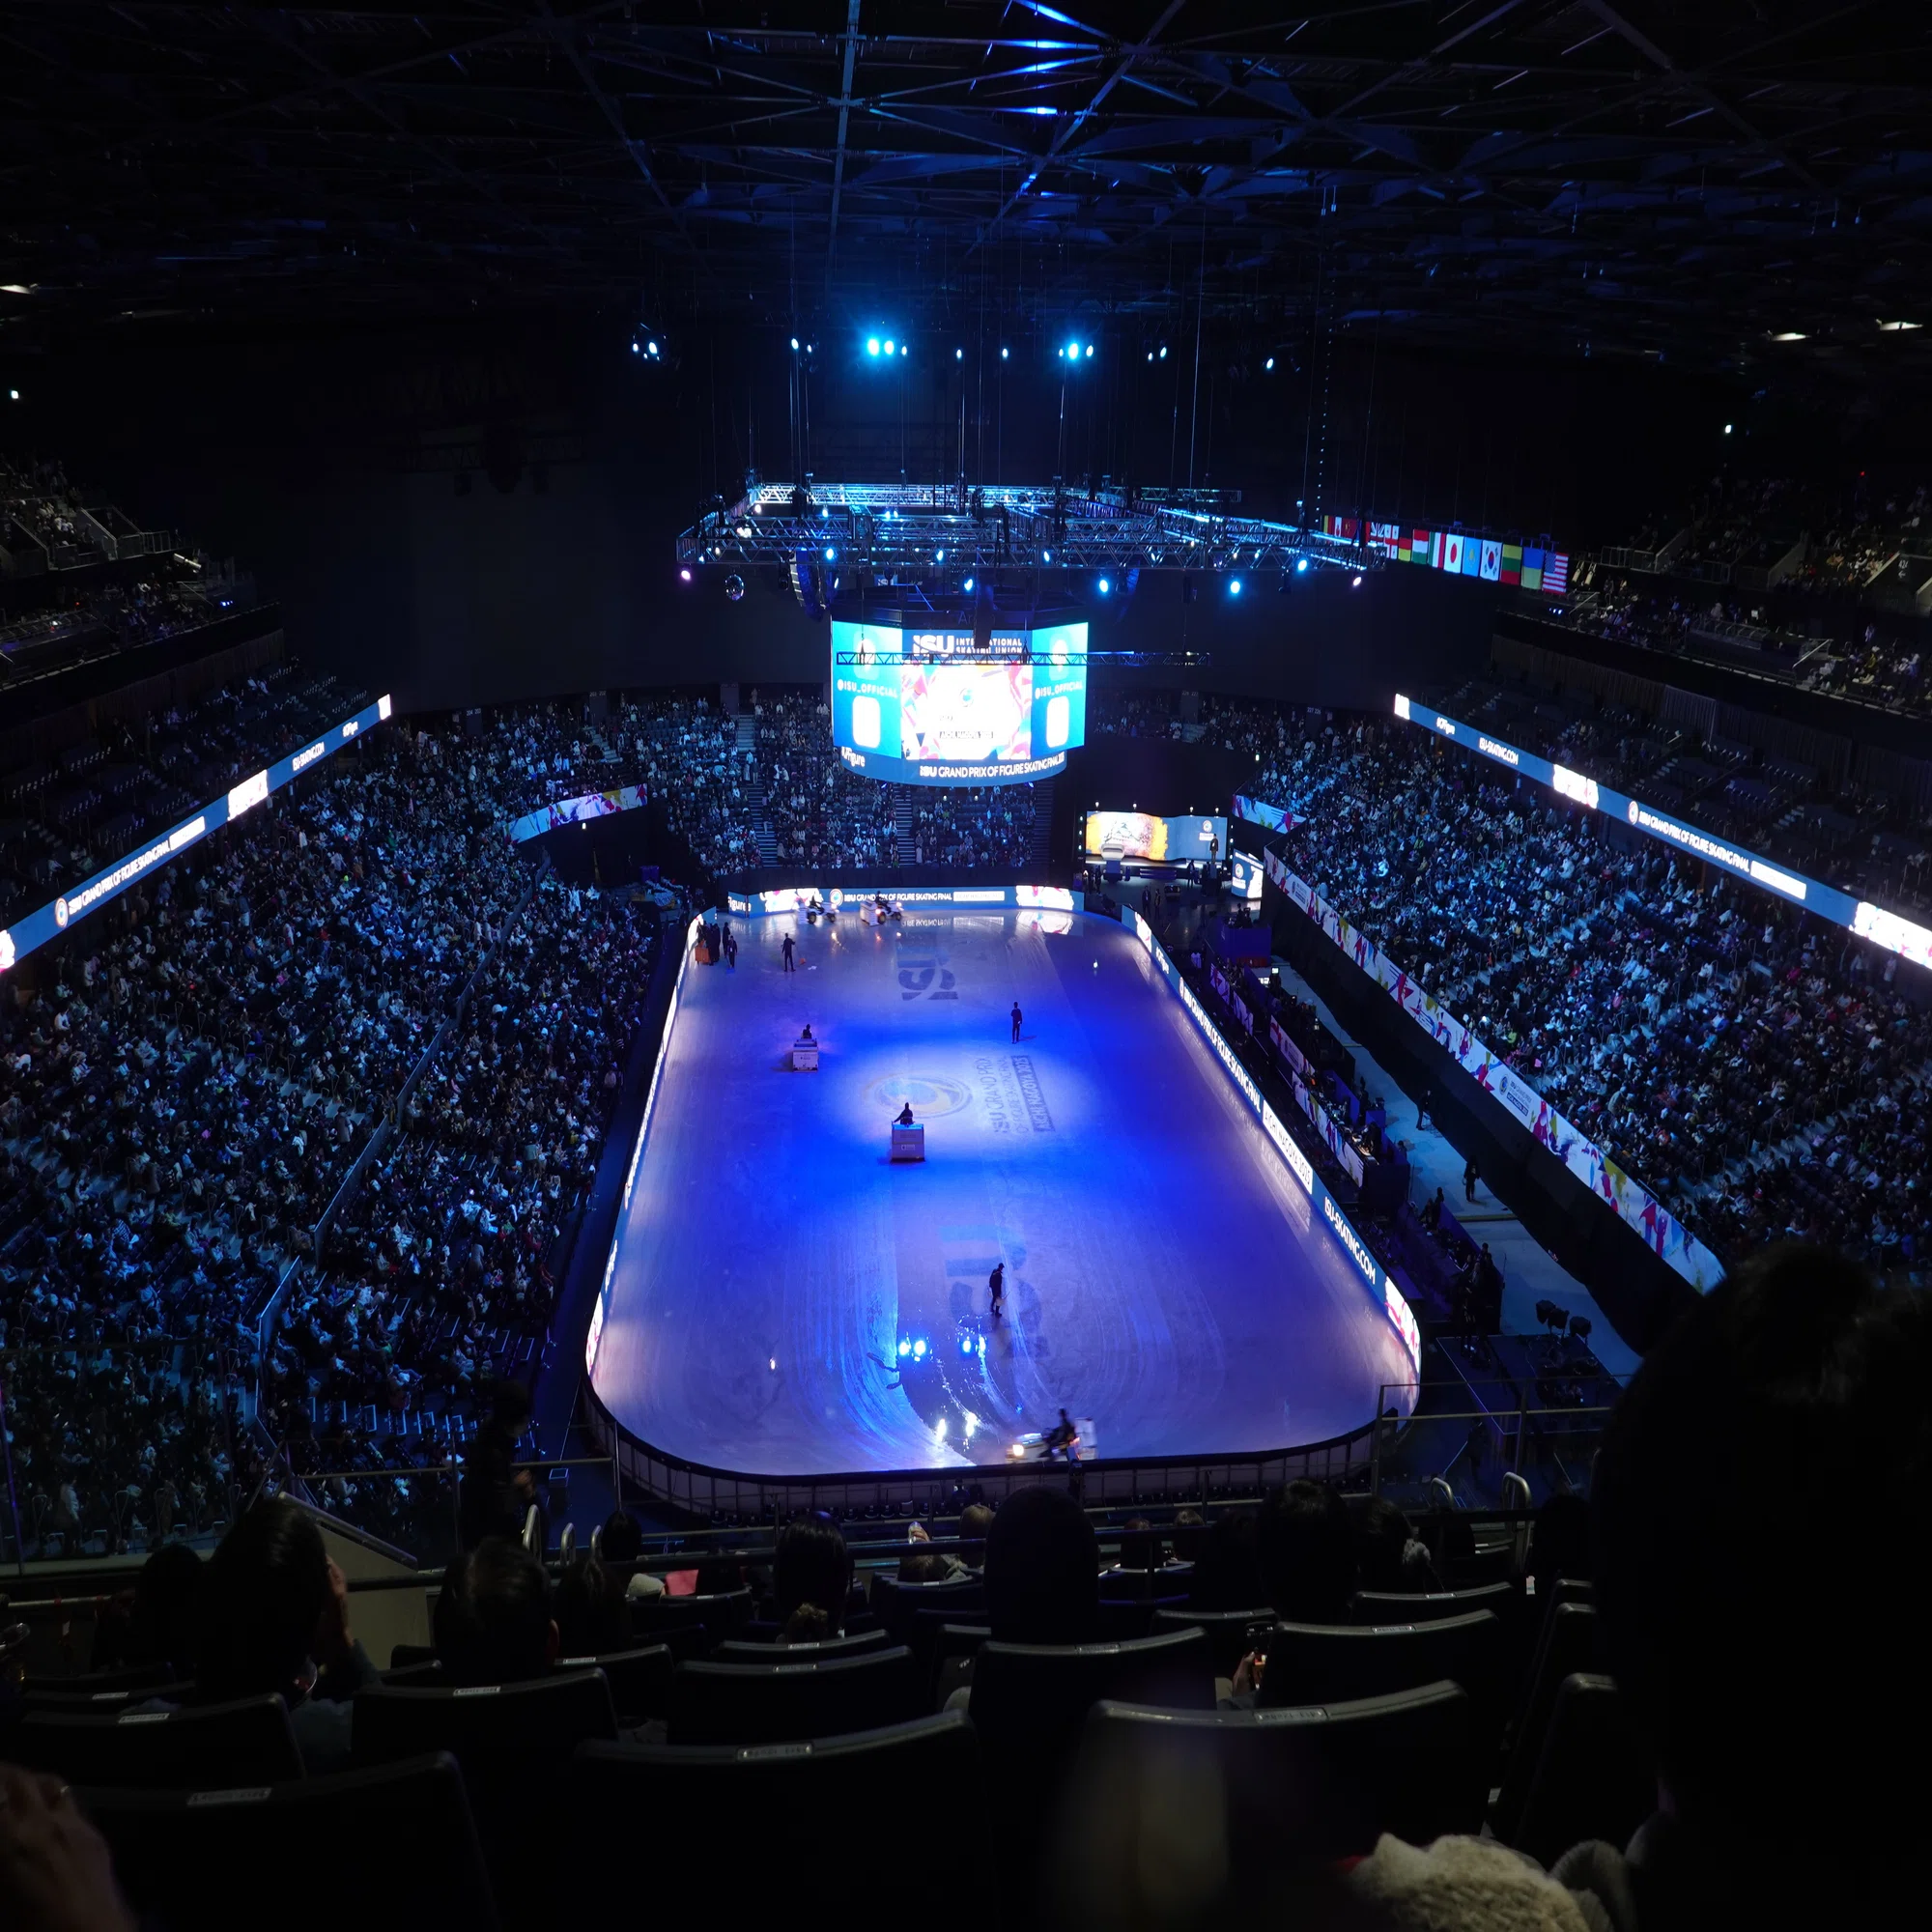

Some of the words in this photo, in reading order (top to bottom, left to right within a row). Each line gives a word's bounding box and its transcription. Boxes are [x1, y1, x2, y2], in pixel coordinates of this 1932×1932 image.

[913, 635, 954, 657] ISU
[956, 638, 1022, 646] INTEATIONAL
[838, 679, 898, 698] @ISU_OFFICIAL
[1036, 680, 1083, 699] @ISU_OFFICIAL
[938, 766, 968, 778] GRAND
[969, 767, 986, 778] PRIX
[987, 766, 999, 778] OF
[1000, 762, 1023, 776] FIGURE
[1024, 759, 1048, 774] SKATING
[896, 893, 916, 901] FIGURE
[937, 892, 952, 900] FINAL
[974, 1056, 994, 1074] PRIX
[1013, 1057, 1032, 1072] 2025
[979, 1076, 1004, 1109] GRAND
[1018, 1073, 1042, 1104] NAGOYA
[1029, 1106, 1051, 1128] AICHI
[1278, 1125, 1296, 1168] NAGOYA
[1298, 1154, 1310, 1186] 2025
[1324, 1196, 1376, 1285] ISU-SKATING.COM
